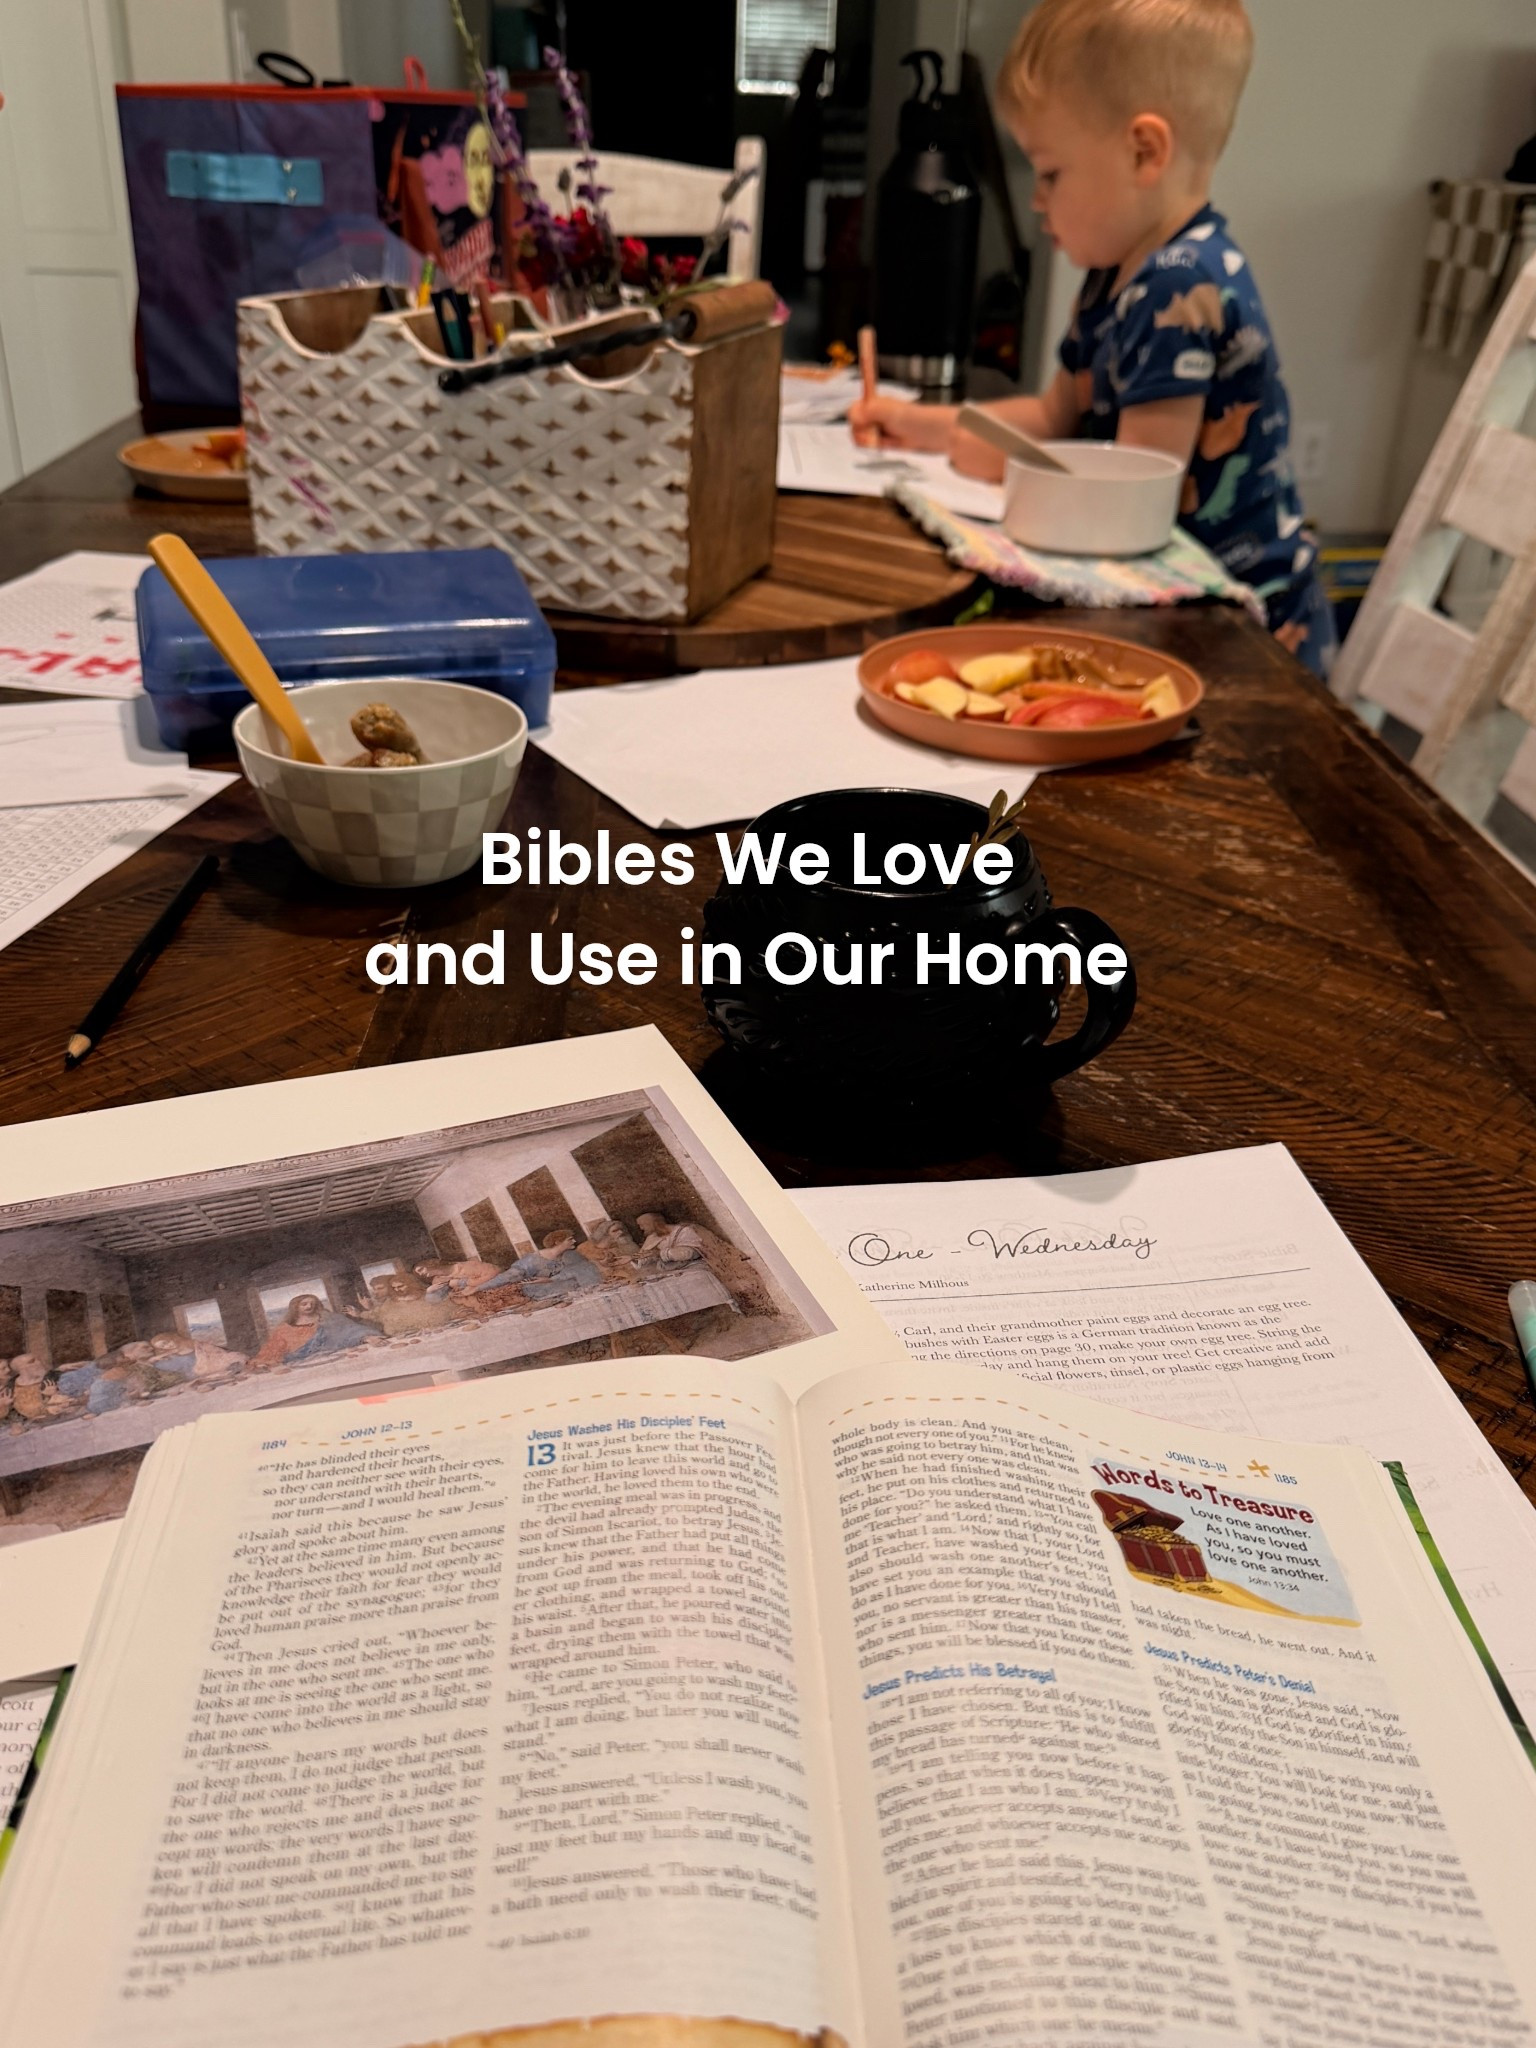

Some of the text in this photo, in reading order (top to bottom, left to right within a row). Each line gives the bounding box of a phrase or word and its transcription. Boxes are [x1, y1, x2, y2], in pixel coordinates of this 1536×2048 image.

[848, 1232, 933, 1266] One
[967, 1227, 1157, 1259] Wednesday
[918, 1279, 969, 1290] Milhous
[903, 1325, 936, 1336] Carl,
[939, 1324, 963, 1334] and
[967, 1322, 997, 1332] their
[1001, 1317, 1083, 1333] grandmother
[1087, 1316, 1120, 1327] paint
[1123, 1314, 1150, 1325] eggs
[1153, 1311, 1178, 1321] and
[1181, 1307, 1235, 1320] decorate
[1238, 1305, 1255, 1314] an
[1258, 1302, 1282, 1313] egg
[1283, 1298, 1312, 1309] tree.
[904, 1314, 1281, 1349] bushes with Easter eggs is a German tradition known as the
[931, 1350, 951, 1360] the
[954, 1347, 1017, 1359] directions
[1020, 1347, 1038, 1355] on
[1040, 1344, 1072, 1357] page
[1074, 1342, 1096, 1353] 30,
[1099, 1340, 1134, 1351] make
[1137, 1341, 1166, 1351] your
[1170, 1337, 1198, 1346] own
[1201, 1335, 1225, 1345] egg
[1226, 1332, 1256, 1342] tree.
[1258, 1327, 1300, 1341] String
[1301, 1323, 1322, 1334] the
[1007, 1359, 1032, 1370] and
[1036, 1356, 1069, 1369] hang
[1072, 1355, 1106, 1366] them
[1109, 1355, 1126, 1364] on
[1129, 1354, 1159, 1364] your
[1162, 1350, 1191, 1360] tree!
[1194, 1348, 1220, 1358] Get
[1223, 1343, 1273, 1356] creative
[1276, 1340, 1302, 1351] and
[1305, 1335, 1331, 1347] add
[1056, 1349, 1335, 1382] flowers, tinsel, or plastic eggs hanging from
[261, 1440, 287, 1450] 1184
[341, 1426, 377, 1440] JOHN
[527, 1428, 564, 1441] Jesus
[567, 1422, 613, 1437] Washes
[616, 1418, 636, 1430] His
[698, 1416, 726, 1429] Feet
[563, 1430, 752, 1451] It was just before the Passover
[831, 1417, 1036, 1446] whole body is clean. And you are
[279, 1454, 445, 1482] and hardened their hearts,
[296, 1444, 431, 1469] has blinded their eyes
[527, 1443, 556, 1466] 13
[1165, 1450, 1196, 1465] JOHN
[262, 1457, 504, 1496] so they can neither see with their eyes,
[274, 1472, 483, 1508] nor understand with their hearts,
[1090, 1462, 1315, 1524] Words to Treasure
[1274, 1473, 1298, 1485] 1185
[271, 1486, 445, 1520] nor I would heal
[1190, 1506, 1312, 1539] Love one another.
[1206, 1522, 1308, 1552] As I have loved
[1204, 1536, 1321, 1568] you, so you must
[1208, 1549, 1329, 1583] love one another.
[1249, 1575, 1301, 1593] John 13:34
[1131, 1599, 1377, 1663] had taken the bread, he went out. And it
[863, 1661, 1057, 1700] Jesus Predicts His Betrayal
[1143, 1640, 1180, 1662] Jesus
[1181, 1650, 1232, 1676] Predicts
[1277, 1674, 1316, 1694] Denial
